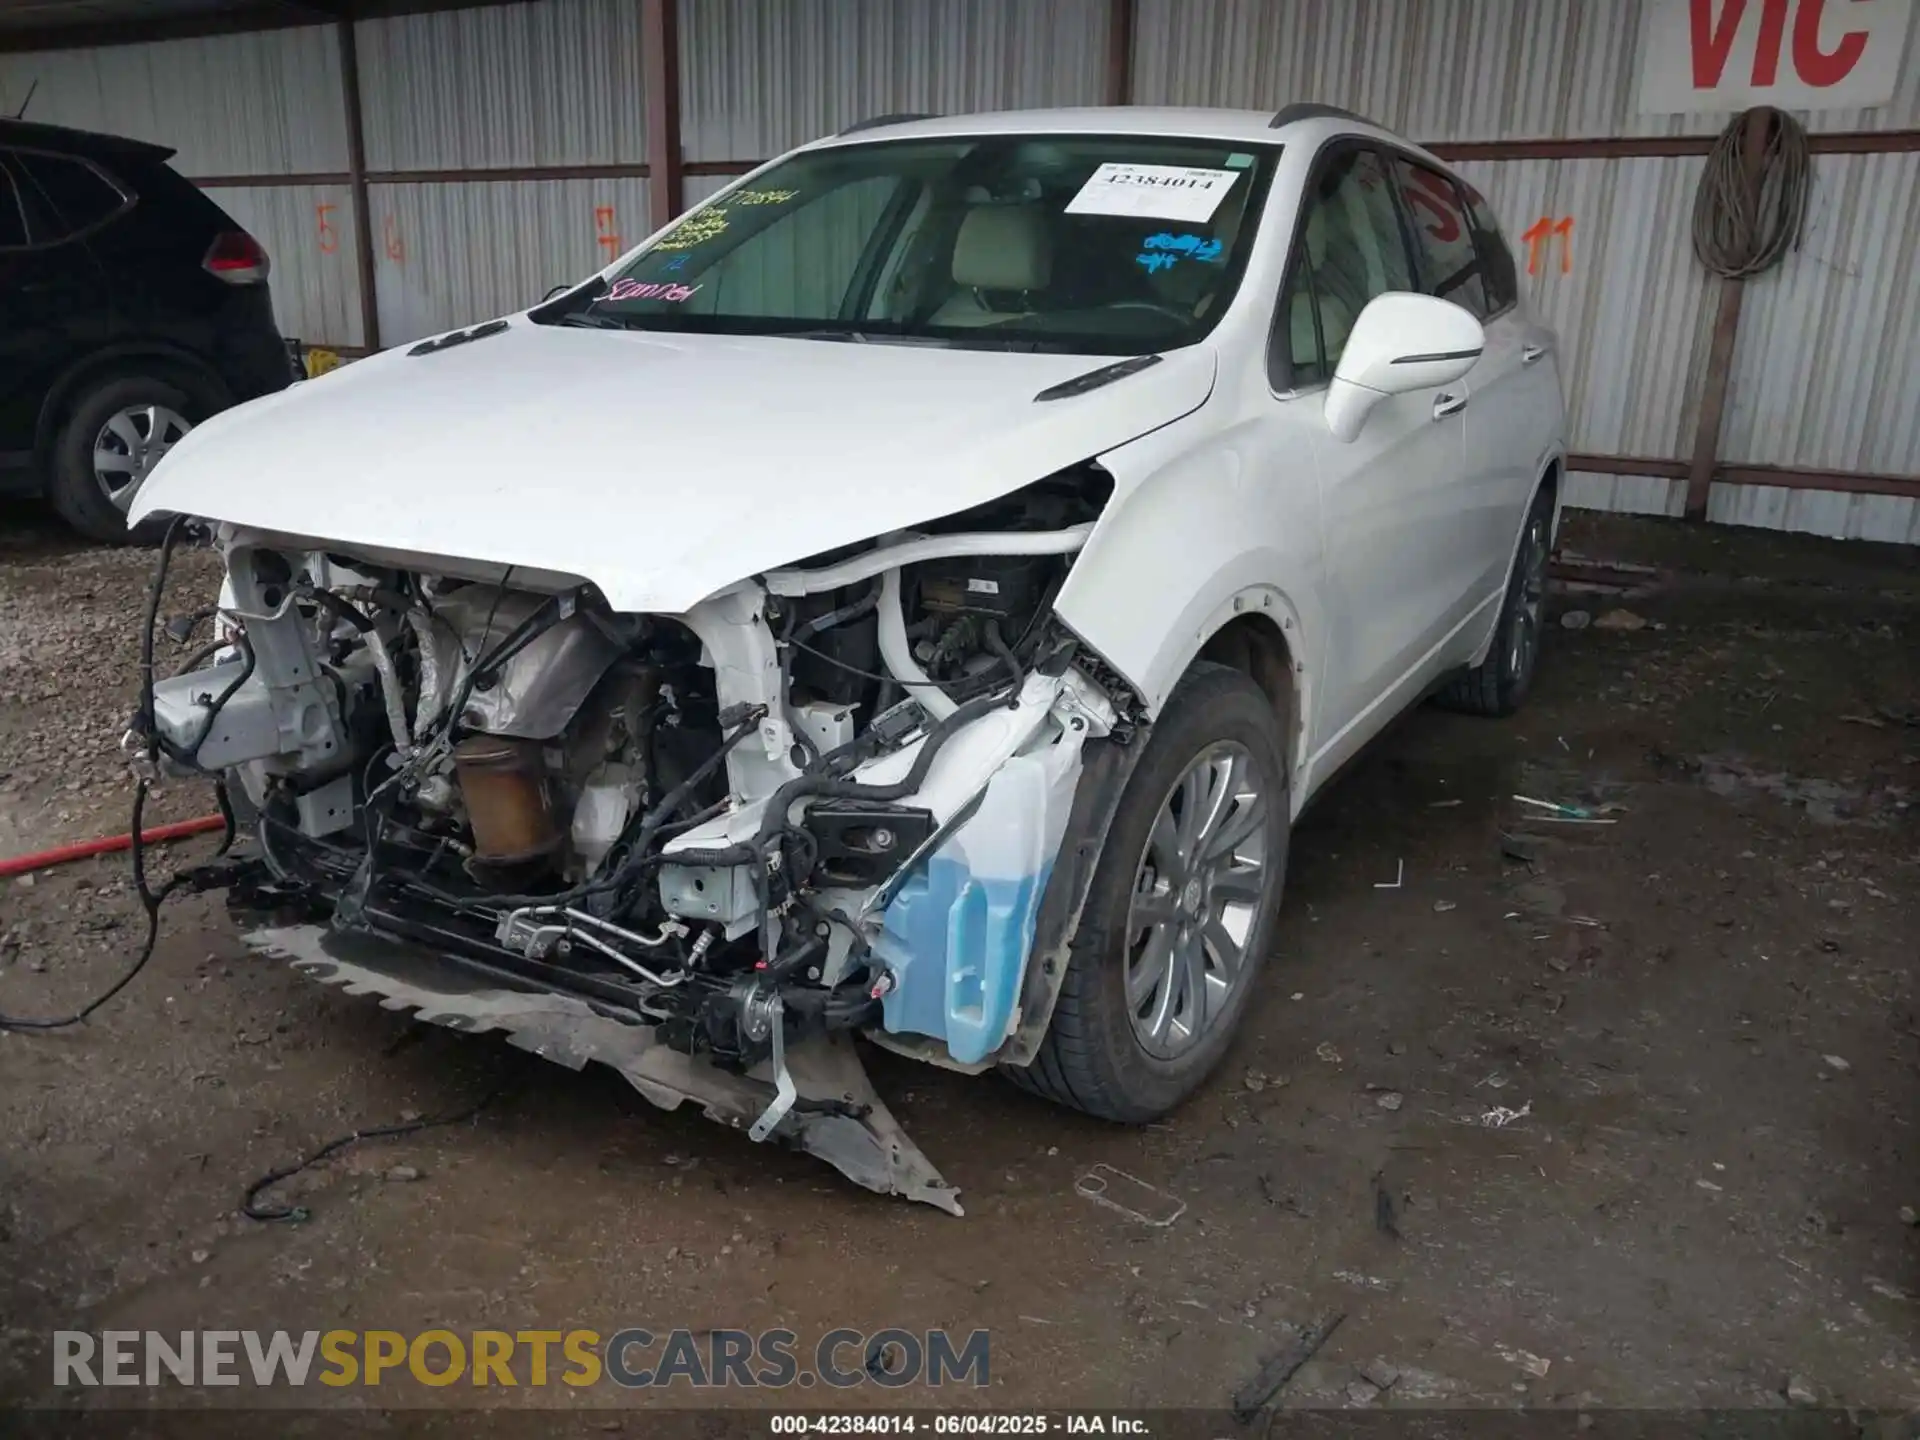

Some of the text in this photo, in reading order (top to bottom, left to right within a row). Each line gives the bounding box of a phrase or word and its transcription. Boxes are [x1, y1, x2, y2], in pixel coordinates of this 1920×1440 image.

[1690, 0, 1870, 89] VIC
[1103, 173, 1214, 190] 42384014
[316, 205, 339, 255] 5
[1521, 216, 1574, 276] 11
